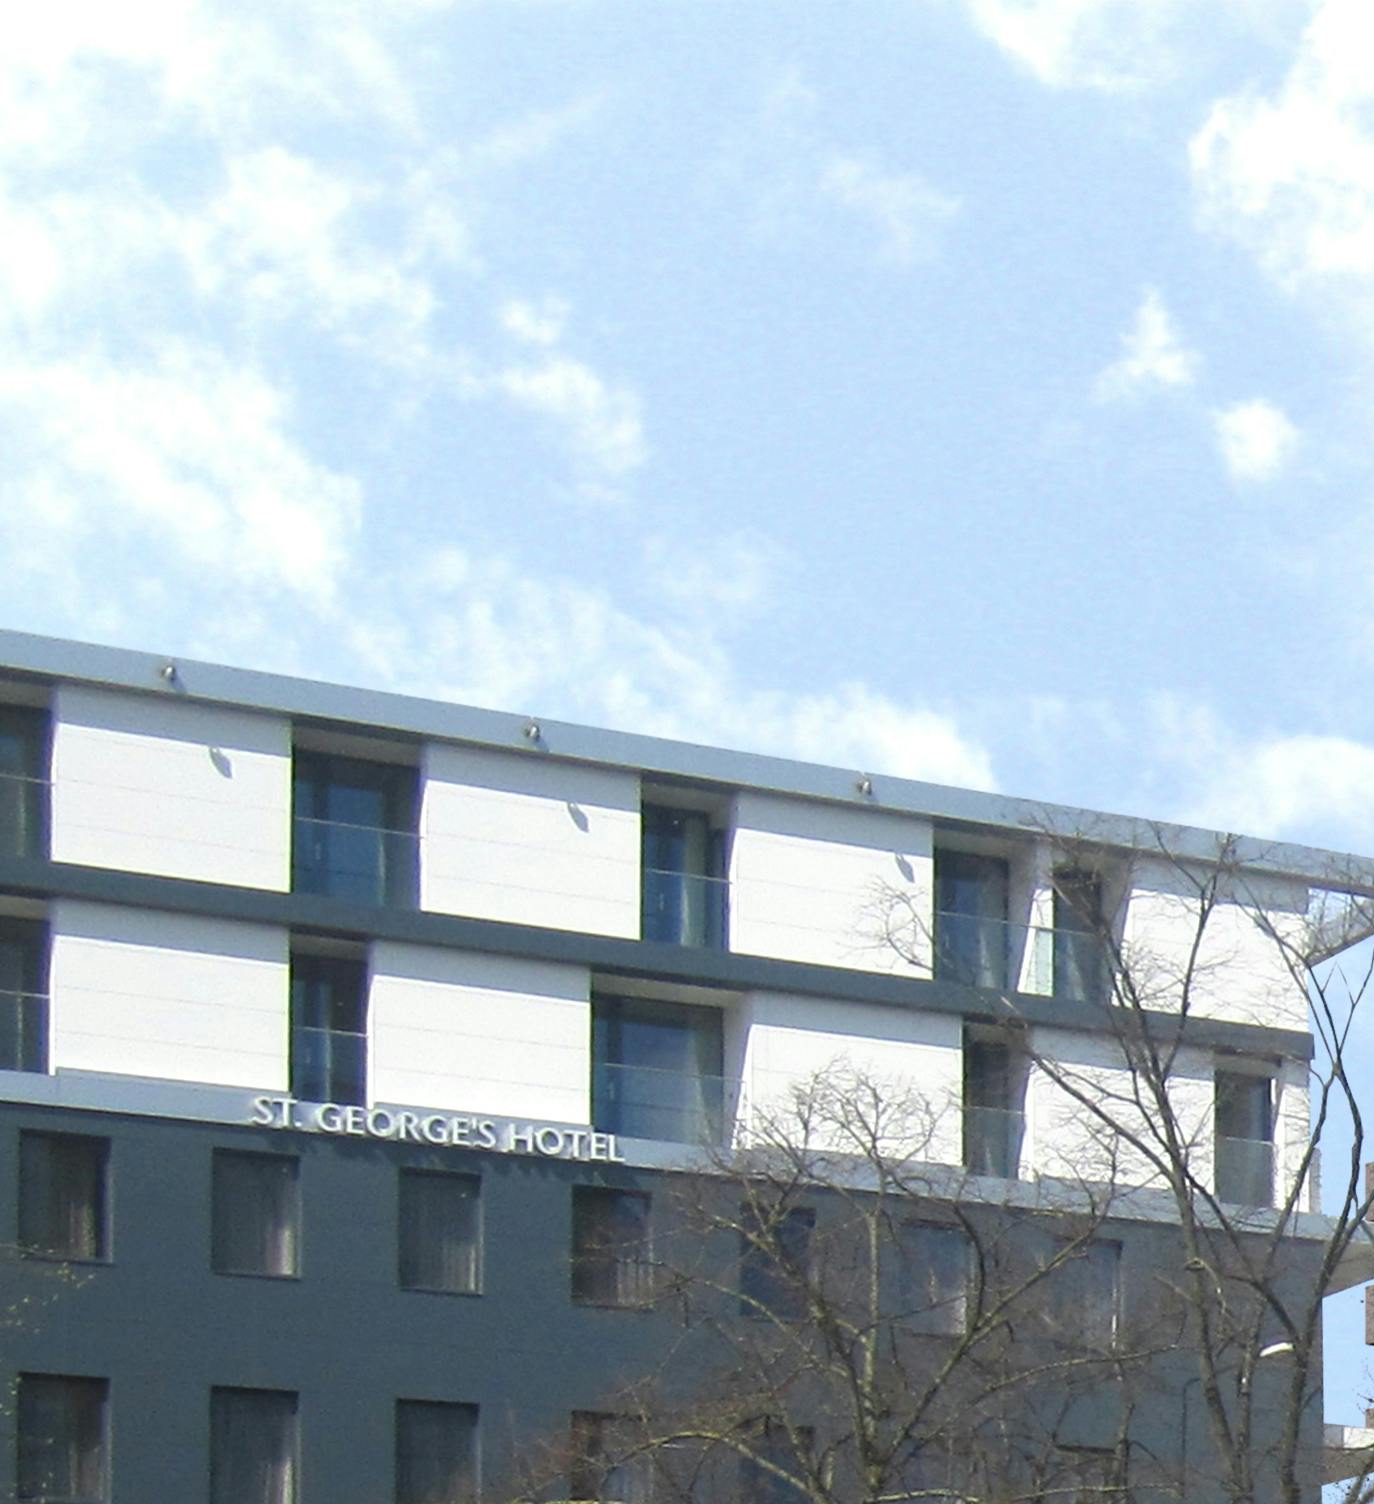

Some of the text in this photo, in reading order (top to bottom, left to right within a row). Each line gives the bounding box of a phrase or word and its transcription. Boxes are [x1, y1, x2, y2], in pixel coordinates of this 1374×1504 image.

[251, 1096, 626, 1162] ST. GEORGE'S HOTEL
